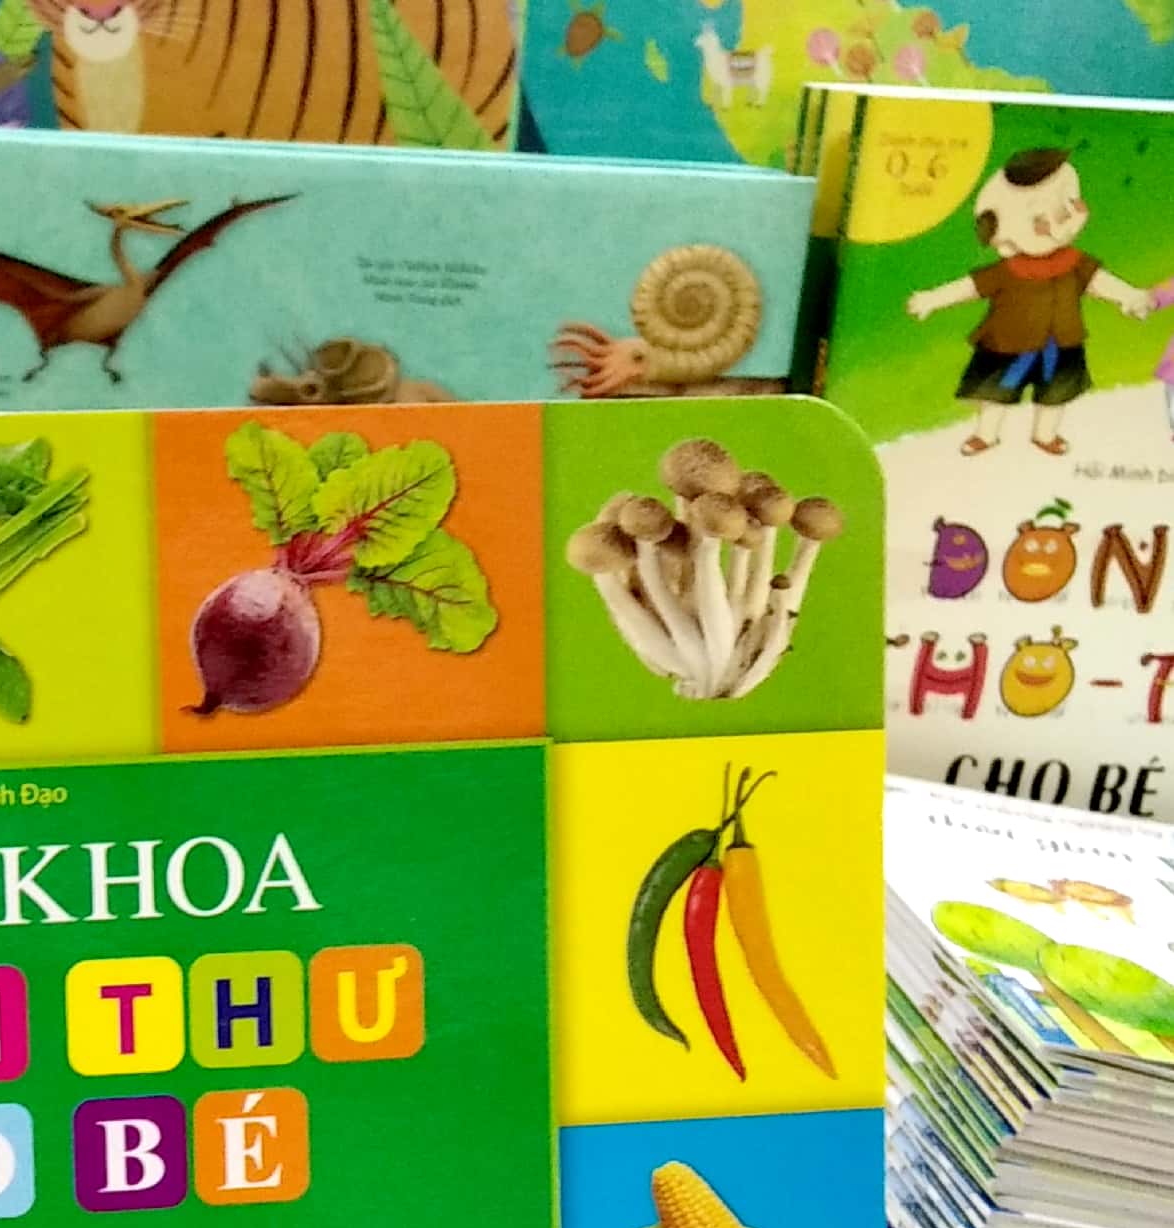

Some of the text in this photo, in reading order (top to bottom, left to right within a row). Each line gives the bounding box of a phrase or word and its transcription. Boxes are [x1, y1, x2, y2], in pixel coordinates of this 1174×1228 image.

[20, 782, 68, 809] Đạo
[1088, 755, 1166, 818] BÉ
[99, 954, 409, 1056] THƯ
[95, 1092, 284, 1194] BÉ
